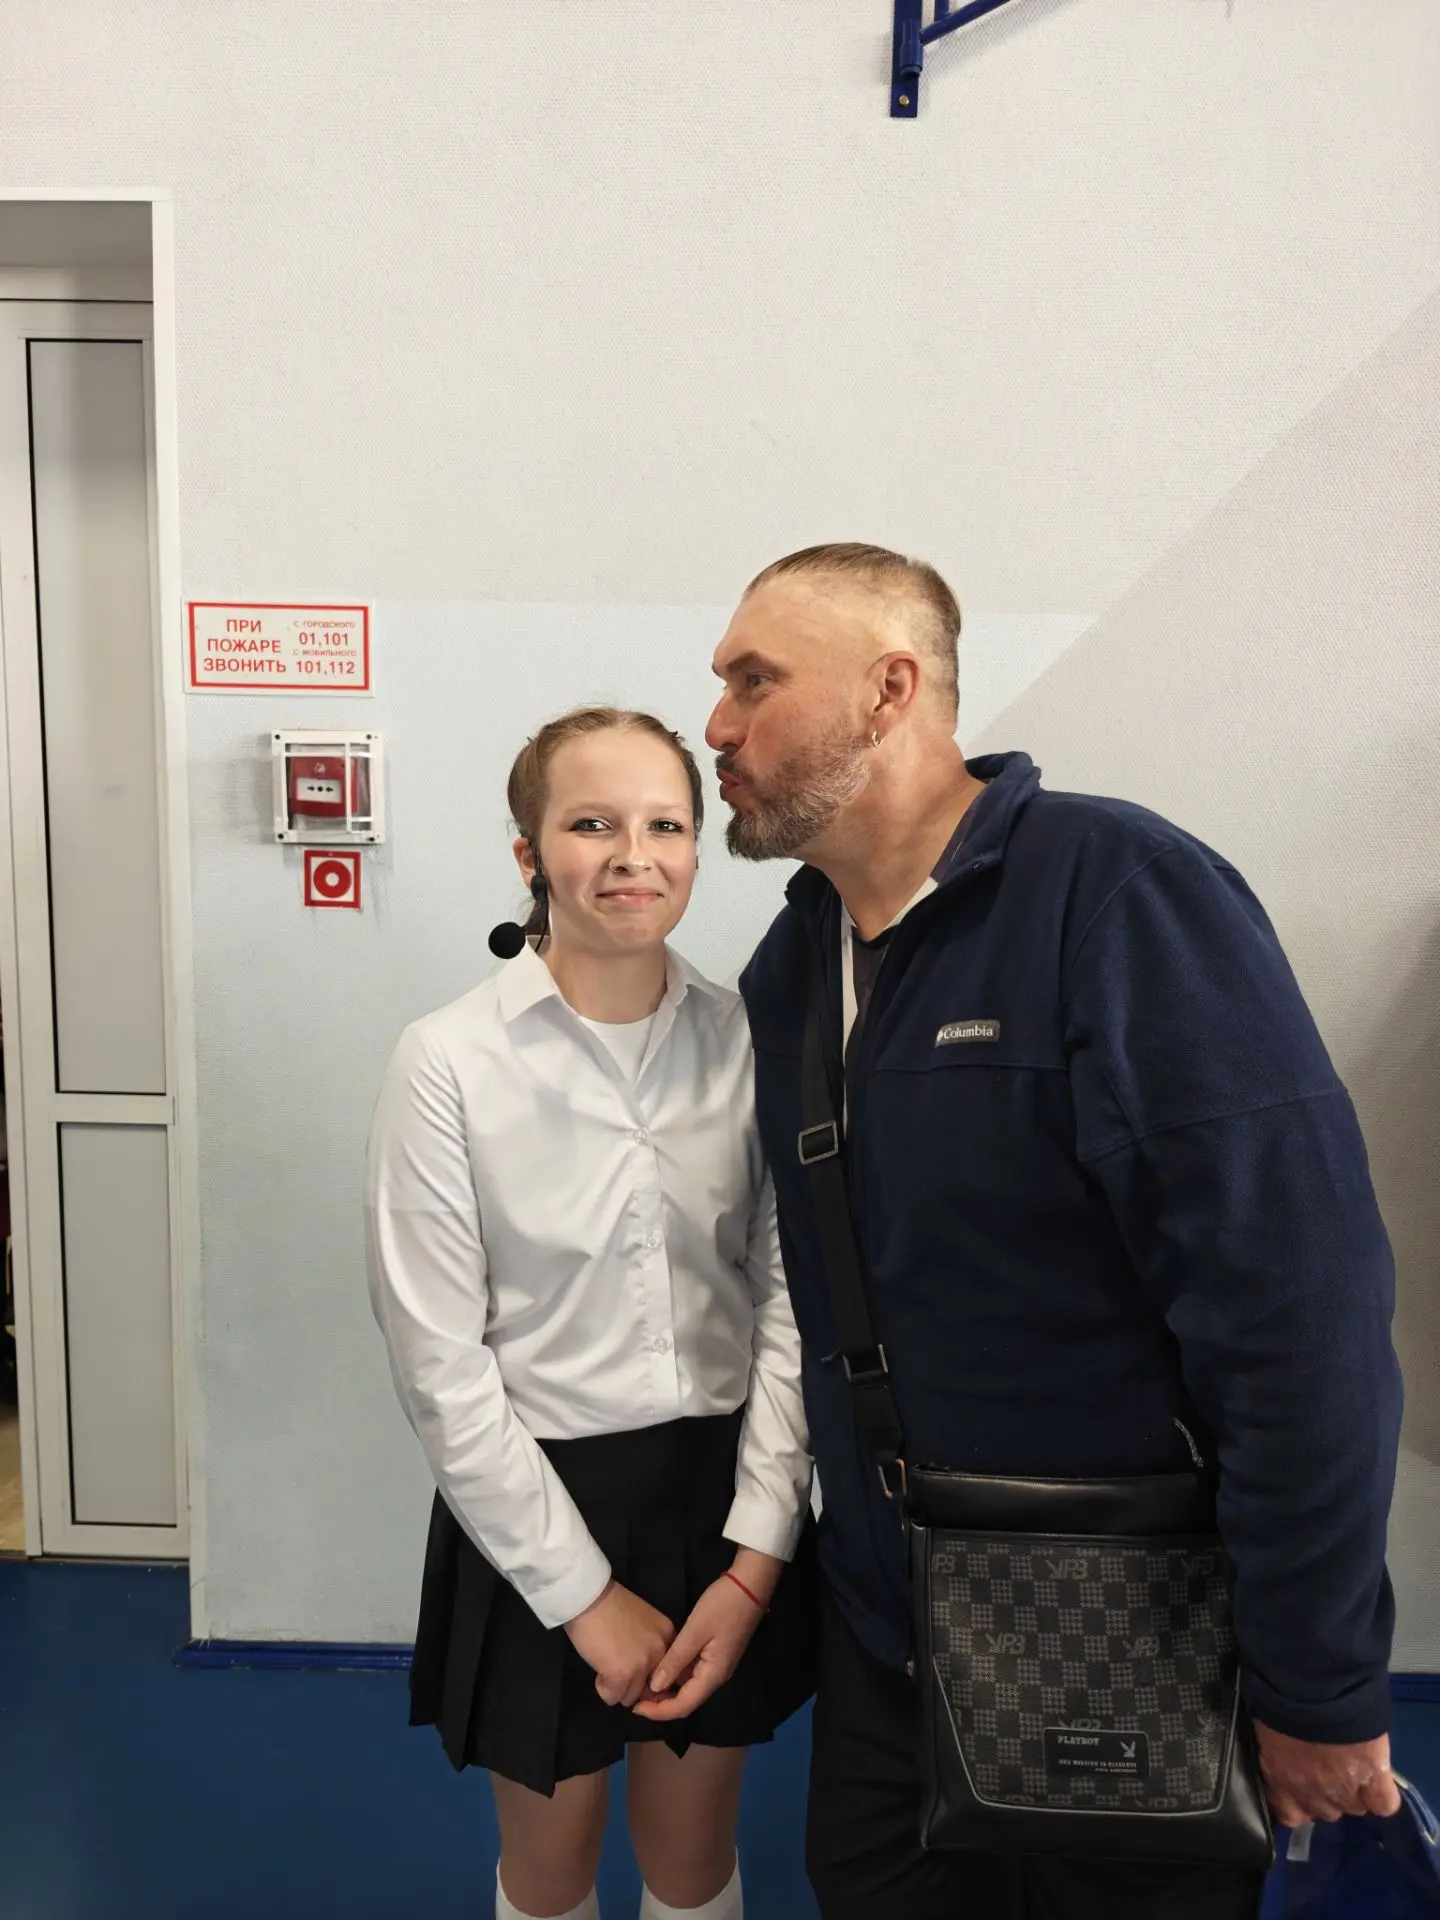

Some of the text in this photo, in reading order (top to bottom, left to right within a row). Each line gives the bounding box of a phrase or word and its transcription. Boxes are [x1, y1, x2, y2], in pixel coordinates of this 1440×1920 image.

[226, 619, 262, 634] ПРИ
[207, 638, 282, 653] ПОЖАРЕ
[299, 632, 349, 647] 01,101
[203, 658, 287, 673] ЗВОНИТЬ
[296, 660, 355, 675] 101,112
[943, 1024, 994, 1040] Columbia
[1057, 1735, 1100, 1746] PLAYBOY
